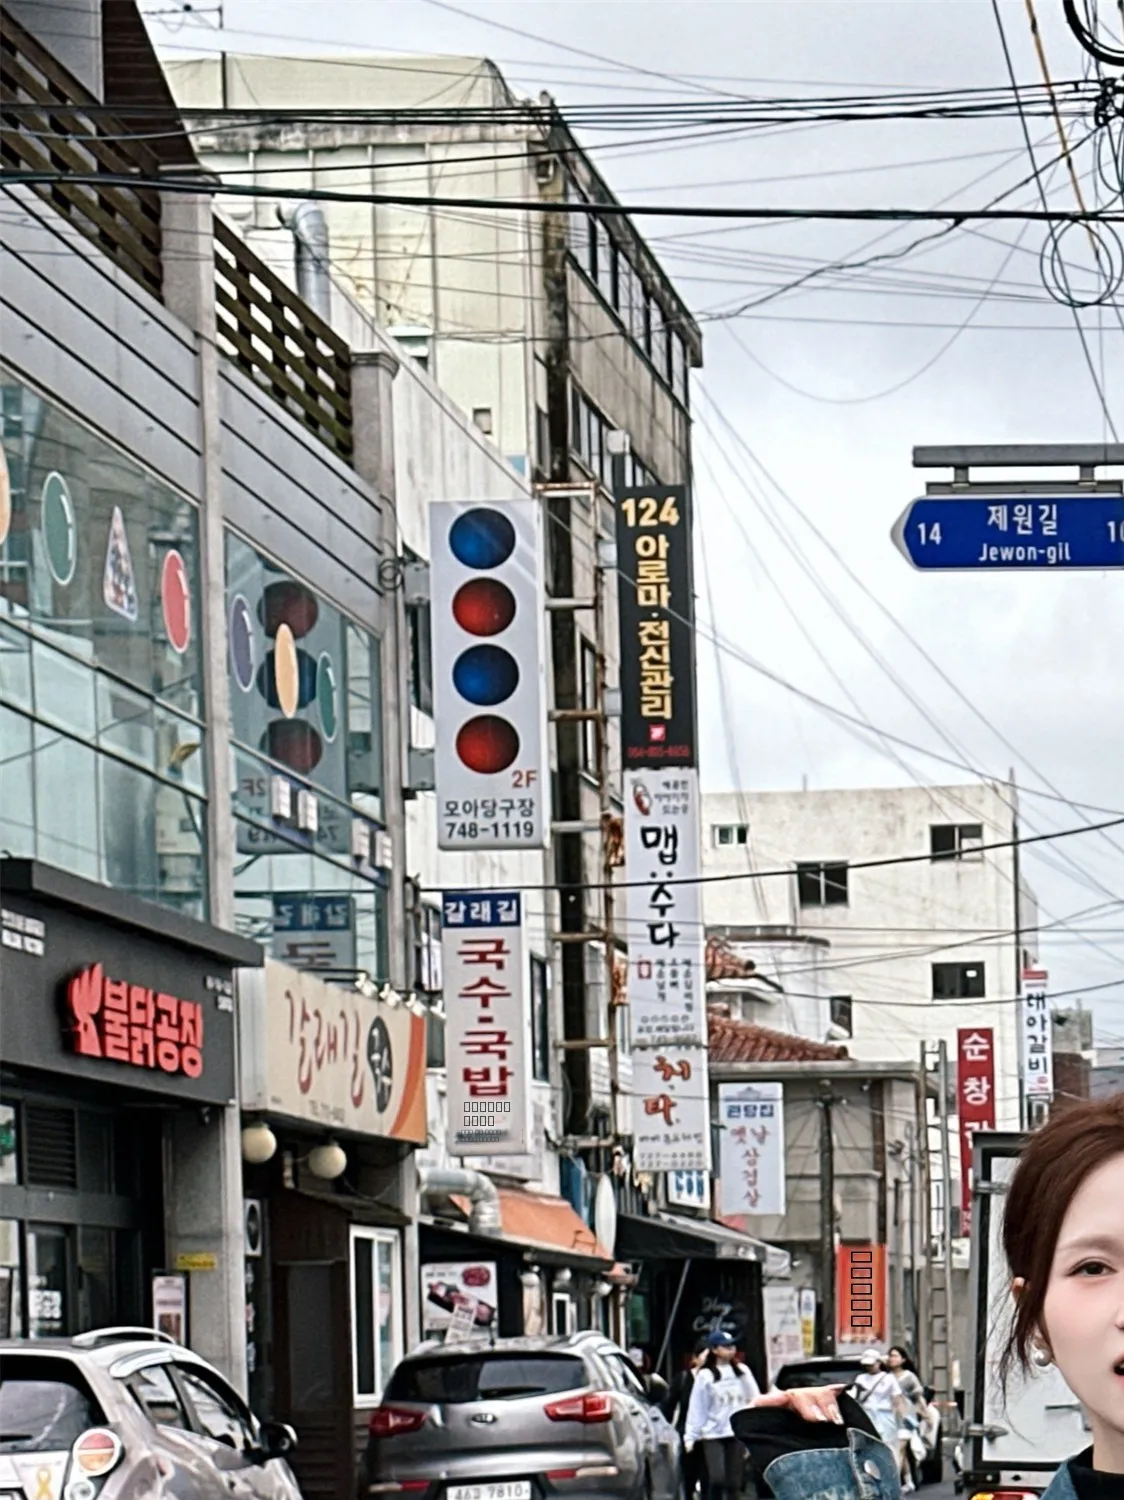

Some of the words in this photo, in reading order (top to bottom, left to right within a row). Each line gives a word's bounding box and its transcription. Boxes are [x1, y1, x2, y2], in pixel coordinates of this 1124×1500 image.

[621, 496, 680, 528] 124
[988, 504, 1058, 535] 제원길
[917, 523, 942, 545] 14
[978, 543, 1071, 564] Jewon-gil
[512, 769, 537, 788] 2F
[444, 798, 535, 818] 모아당구장
[446, 821, 535, 839] 748-1119
[445, 899, 517, 924] 갈래길
[104, 968, 203, 1078] 불닭공장
[1027, 992, 1047, 1074] 대아갈비
